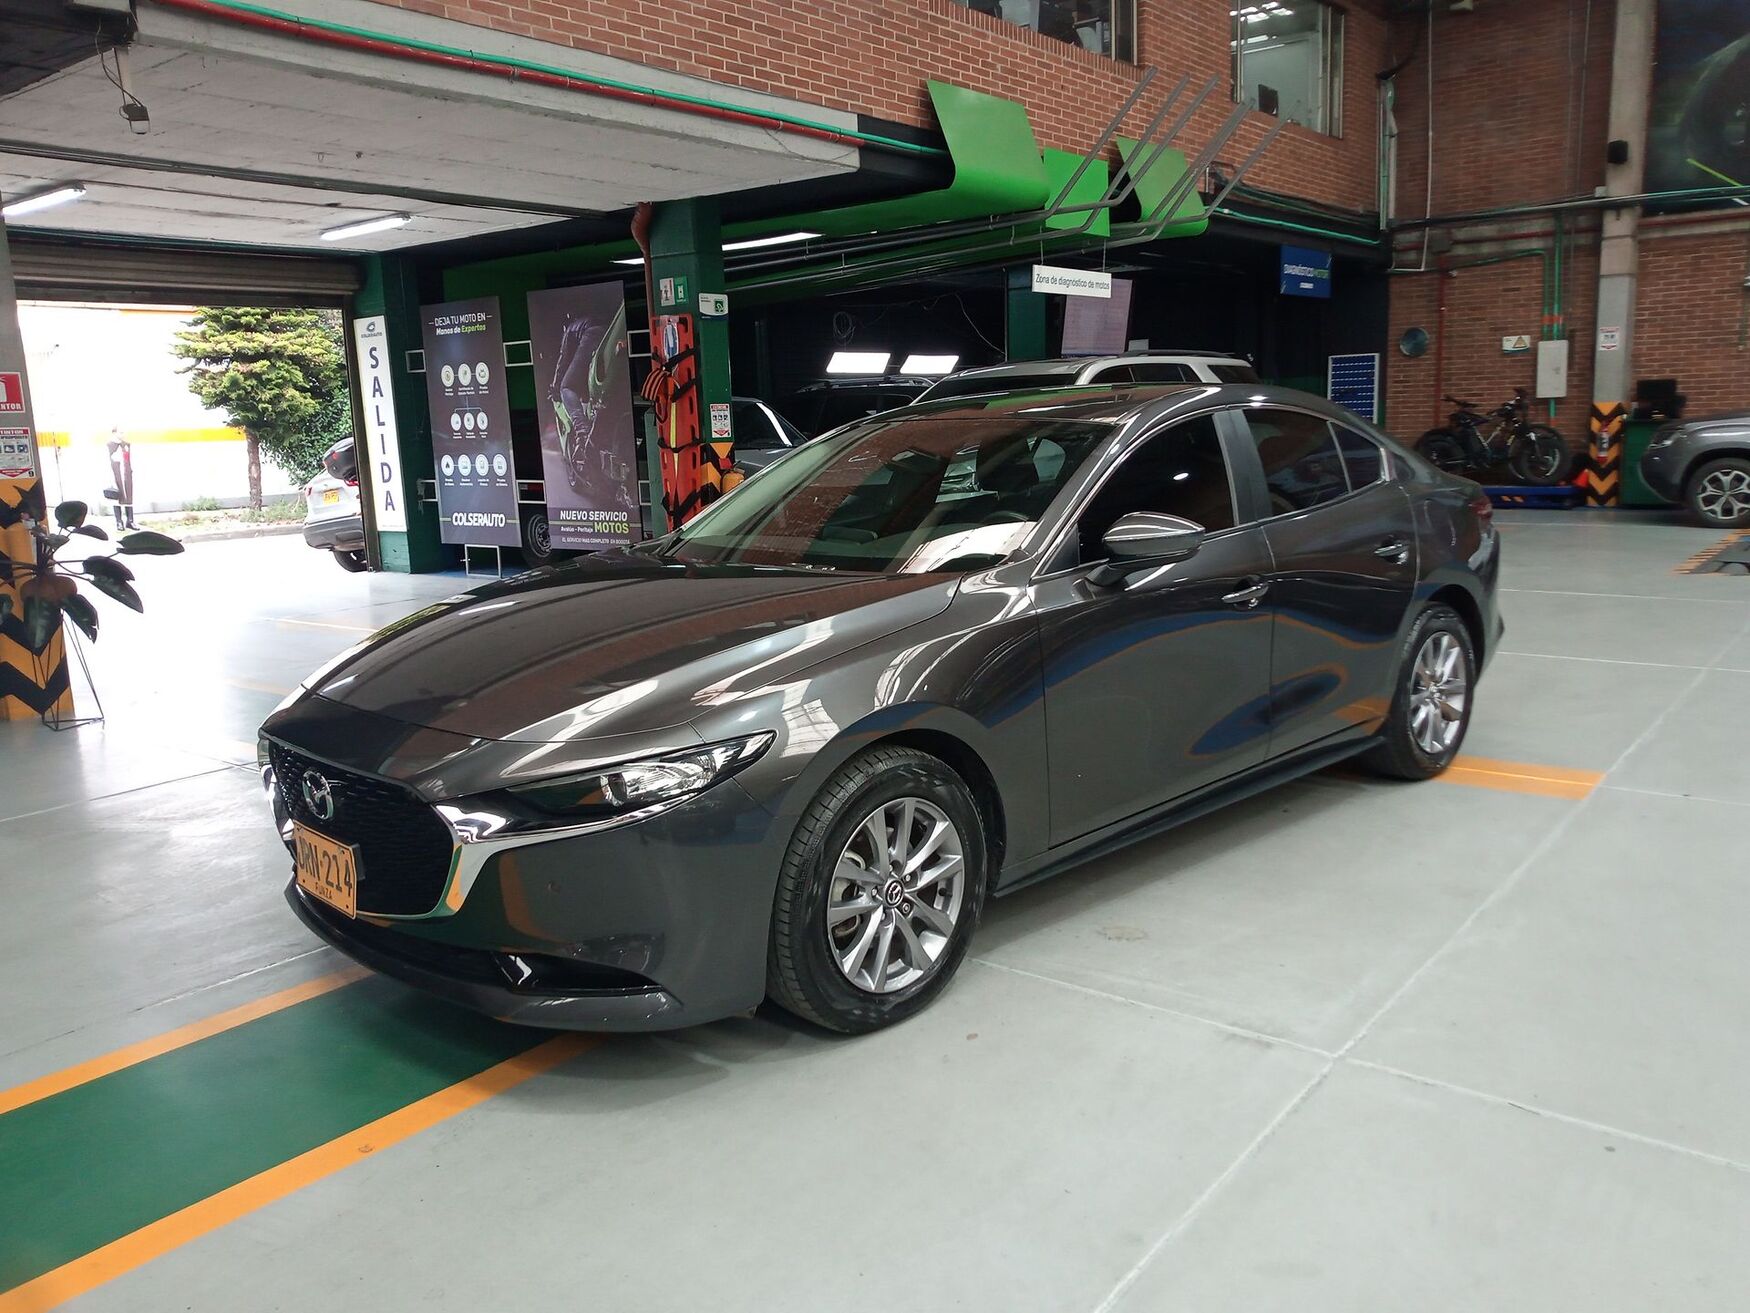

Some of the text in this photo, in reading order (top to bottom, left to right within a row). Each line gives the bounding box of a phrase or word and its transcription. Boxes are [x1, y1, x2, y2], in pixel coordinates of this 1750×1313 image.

[1035, 273, 1050, 284] Zona
[1050, 275, 1058, 285] de
[1087, 280, 1095, 289] de
[1095, 281, 1110, 290] motos
[434, 312, 486, 327] DEJA TU MOTO EN
[436, 324, 486, 336] Manos de Expertos
[369, 346, 396, 512] SALIDA
[452, 512, 506, 528] COLSERAUTO
[560, 510, 628, 522] NUEVO SERVICIO
[594, 522, 630, 534] MOTOS
